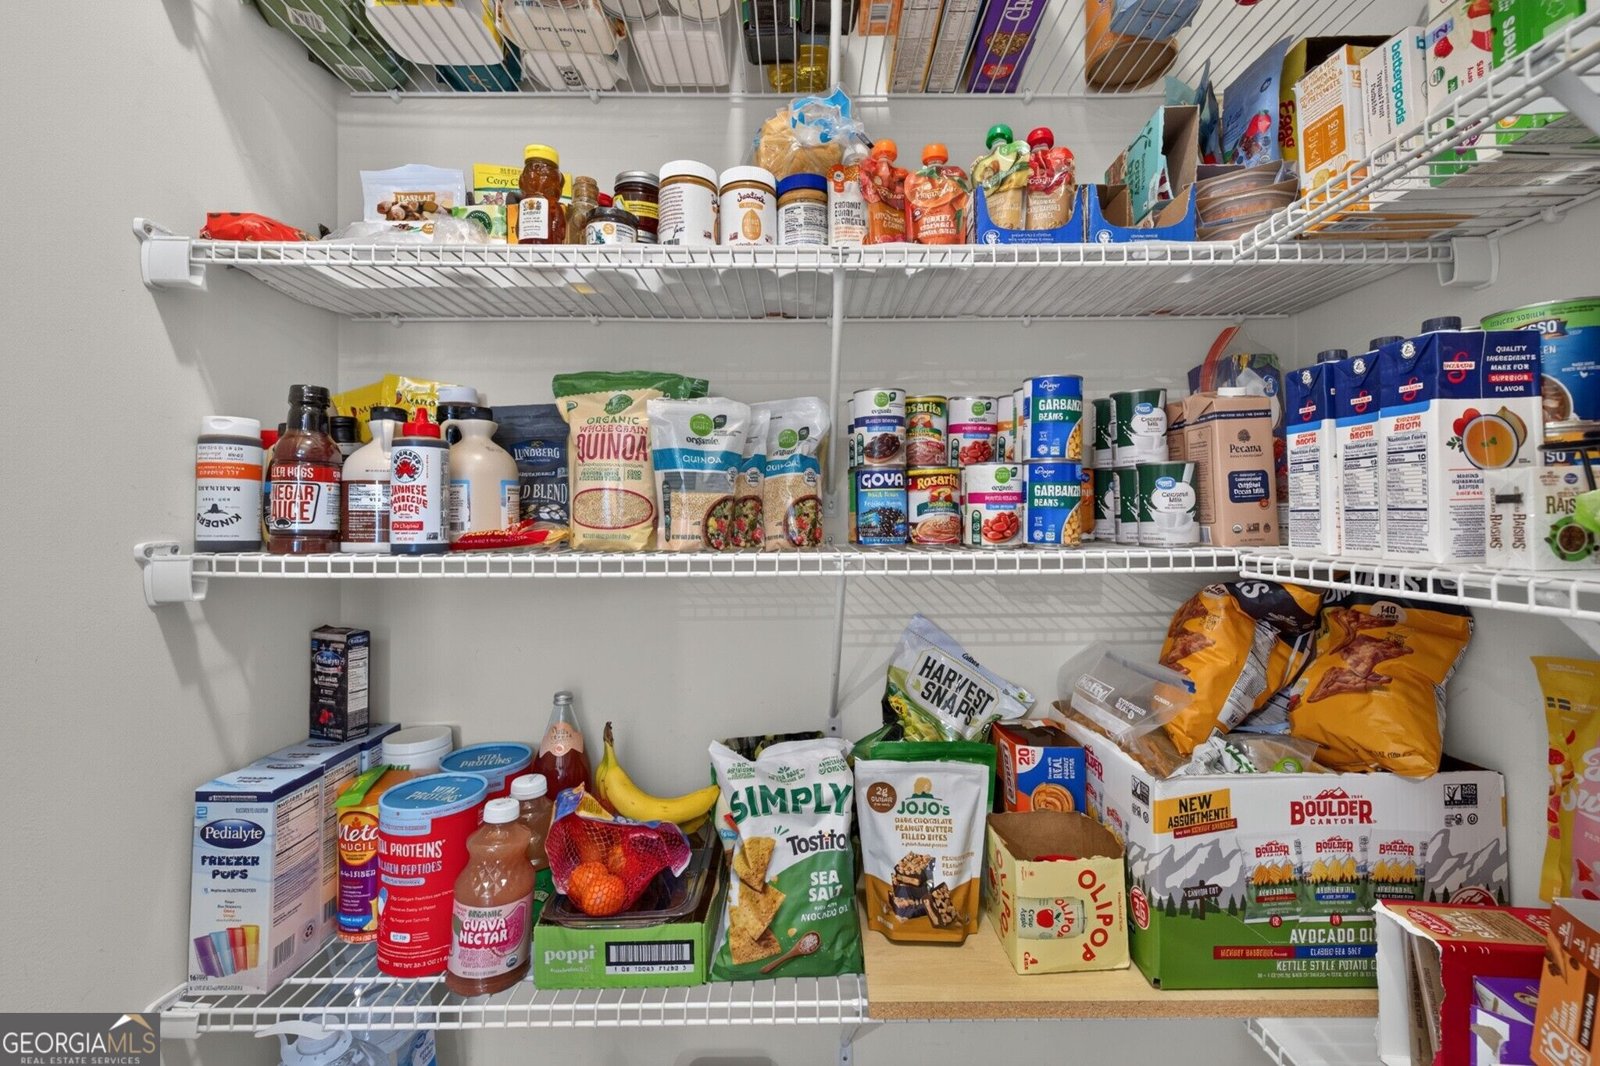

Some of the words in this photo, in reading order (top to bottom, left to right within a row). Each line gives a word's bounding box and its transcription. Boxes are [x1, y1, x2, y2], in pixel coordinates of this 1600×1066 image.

[1391, 39, 1406, 126] bettergoods
[587, 416, 639, 425] ORGANIC
[1038, 412, 1064, 421] BEANS
[580, 425, 613, 434] WHOLE
[615, 425, 648, 434] GRAIN
[514, 447, 560, 460] LUNDBERG
[576, 434, 648, 462] QUINOA
[1229, 444, 1262, 454] Pecana
[682, 455, 722, 464] QUINOA
[271, 466, 286, 478] LLER
[287, 466, 314, 478] HOGS
[861, 472, 904, 488] GOYA
[272, 484, 314, 501] NEGAR
[533, 484, 568, 504] BLEND
[393, 505, 420, 515] SAUCE
[1034, 497, 1059, 507] BEANS
[1545, 496, 1576, 514] RAIS
[271, 501, 311, 522] AUCE
[1380, 605, 1396, 614] 140
[919, 655, 994, 715] HARVEST
[920, 682, 976, 726] SNAPS
[1018, 748, 1030, 765] 20
[1054, 757, 1062, 779] REAL
[876, 787, 888, 797] 2g
[730, 783, 853, 826] SIMPLY
[1178, 794, 1212, 813] NEW
[1168, 806, 1229, 829] ASSORTMENT!
[1290, 800, 1373, 825] BOULDER
[205, 826, 263, 842] Pedialyte
[390, 841, 443, 858] PROTEINS
[786, 829, 847, 856] Tostito
[1255, 843, 1290, 858] BOULDER
[1315, 838, 1353, 853] BOULDER
[1379, 843, 1414, 856] BOULDER
[201, 855, 260, 866] FREEZER
[401, 860, 442, 875] PEPTIDES
[212, 869, 248, 879] POPS
[810, 870, 840, 886] SEA
[808, 884, 843, 902] SALT
[1078, 869, 1114, 962] OLIPOP
[463, 918, 506, 930] GUAVA
[459, 929, 507, 944] NECTAR
[1289, 928, 1354, 943] AVOCADO
[544, 945, 596, 964] poppi
[1276, 960, 1307, 971] KETTLE
[1311, 960, 1337, 970] STYLE
[1339, 960, 1368, 970] POTATO
